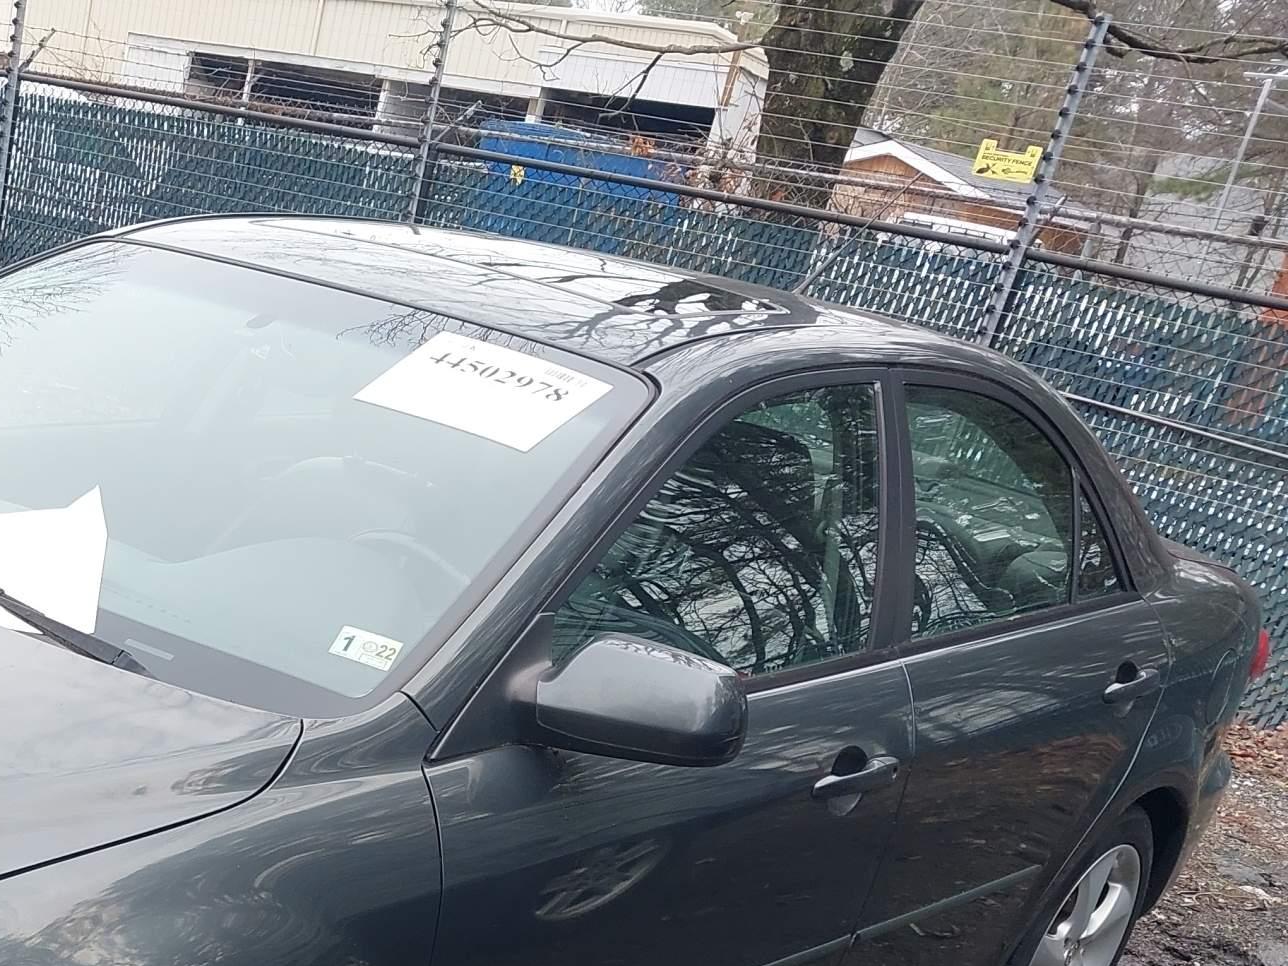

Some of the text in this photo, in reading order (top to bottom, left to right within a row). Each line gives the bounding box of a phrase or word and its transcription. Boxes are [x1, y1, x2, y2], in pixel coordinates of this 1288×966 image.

[981, 154, 1011, 163] SECURITY
[1012, 158, 1034, 167] FENCE
[429, 352, 570, 402] 44502978
[342, 634, 357, 652] 1
[375, 643, 398, 661] 22
